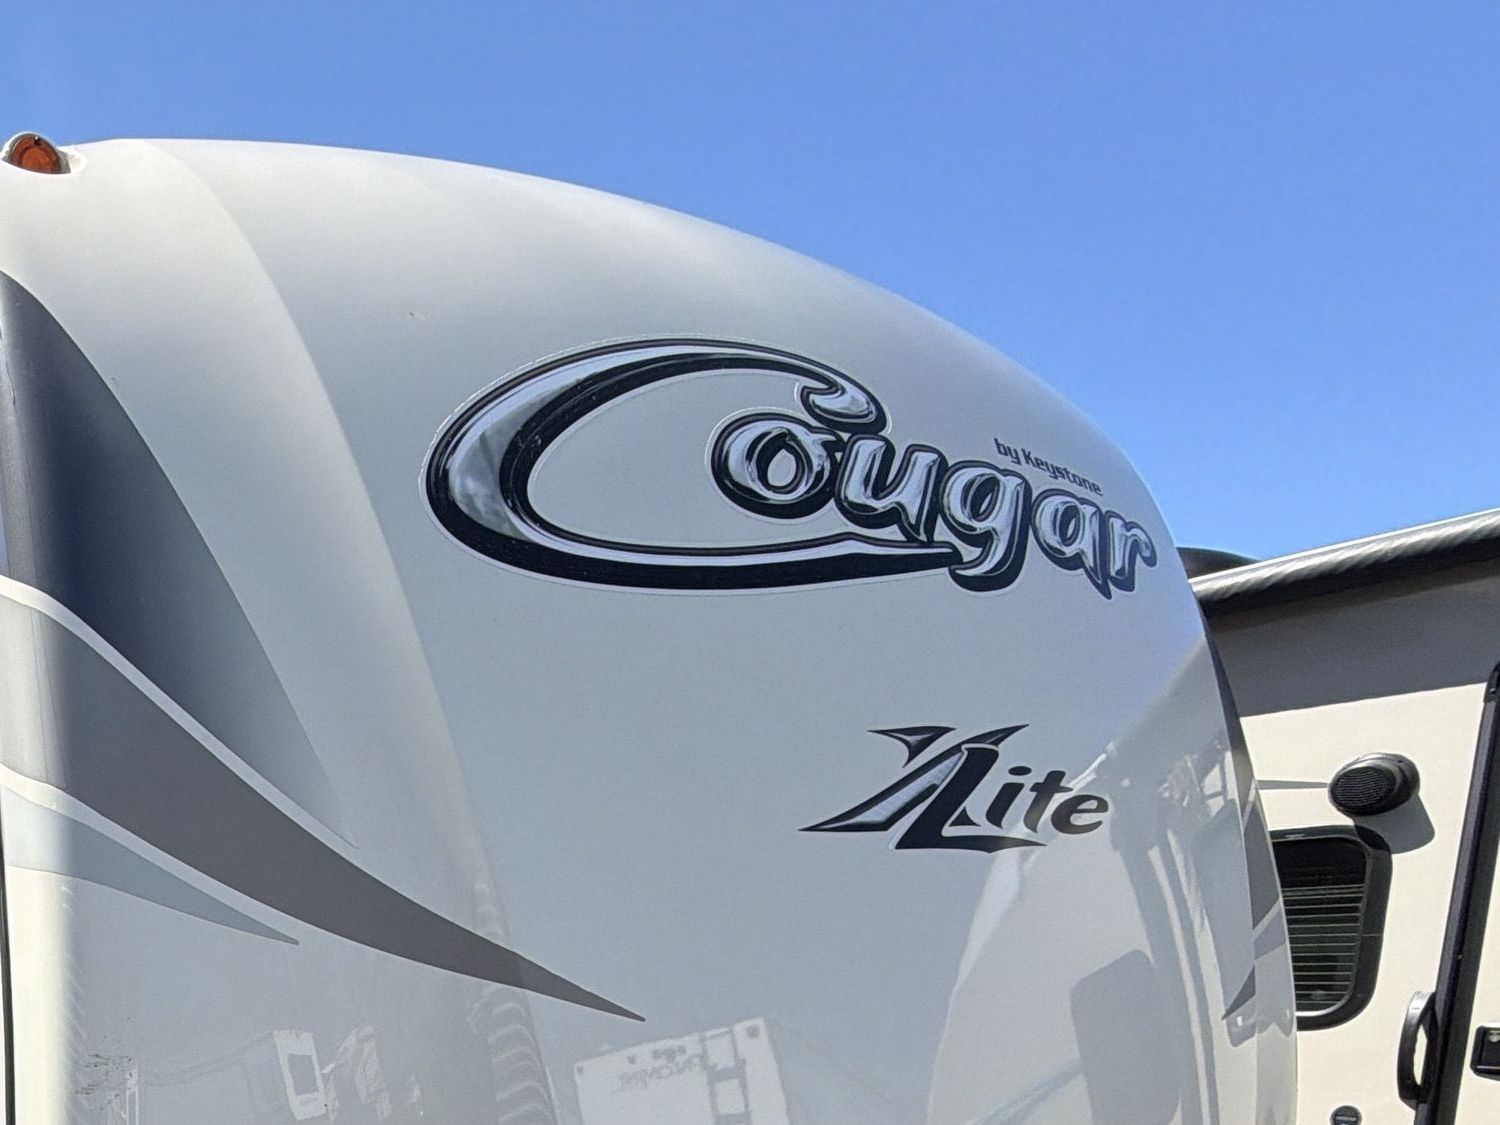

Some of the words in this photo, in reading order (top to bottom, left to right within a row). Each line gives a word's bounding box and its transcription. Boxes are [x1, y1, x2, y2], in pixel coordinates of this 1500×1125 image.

[425, 338, 1157, 599] Cougar
[994, 437, 1021, 465] by
[1021, 448, 1103, 496] Keystone
